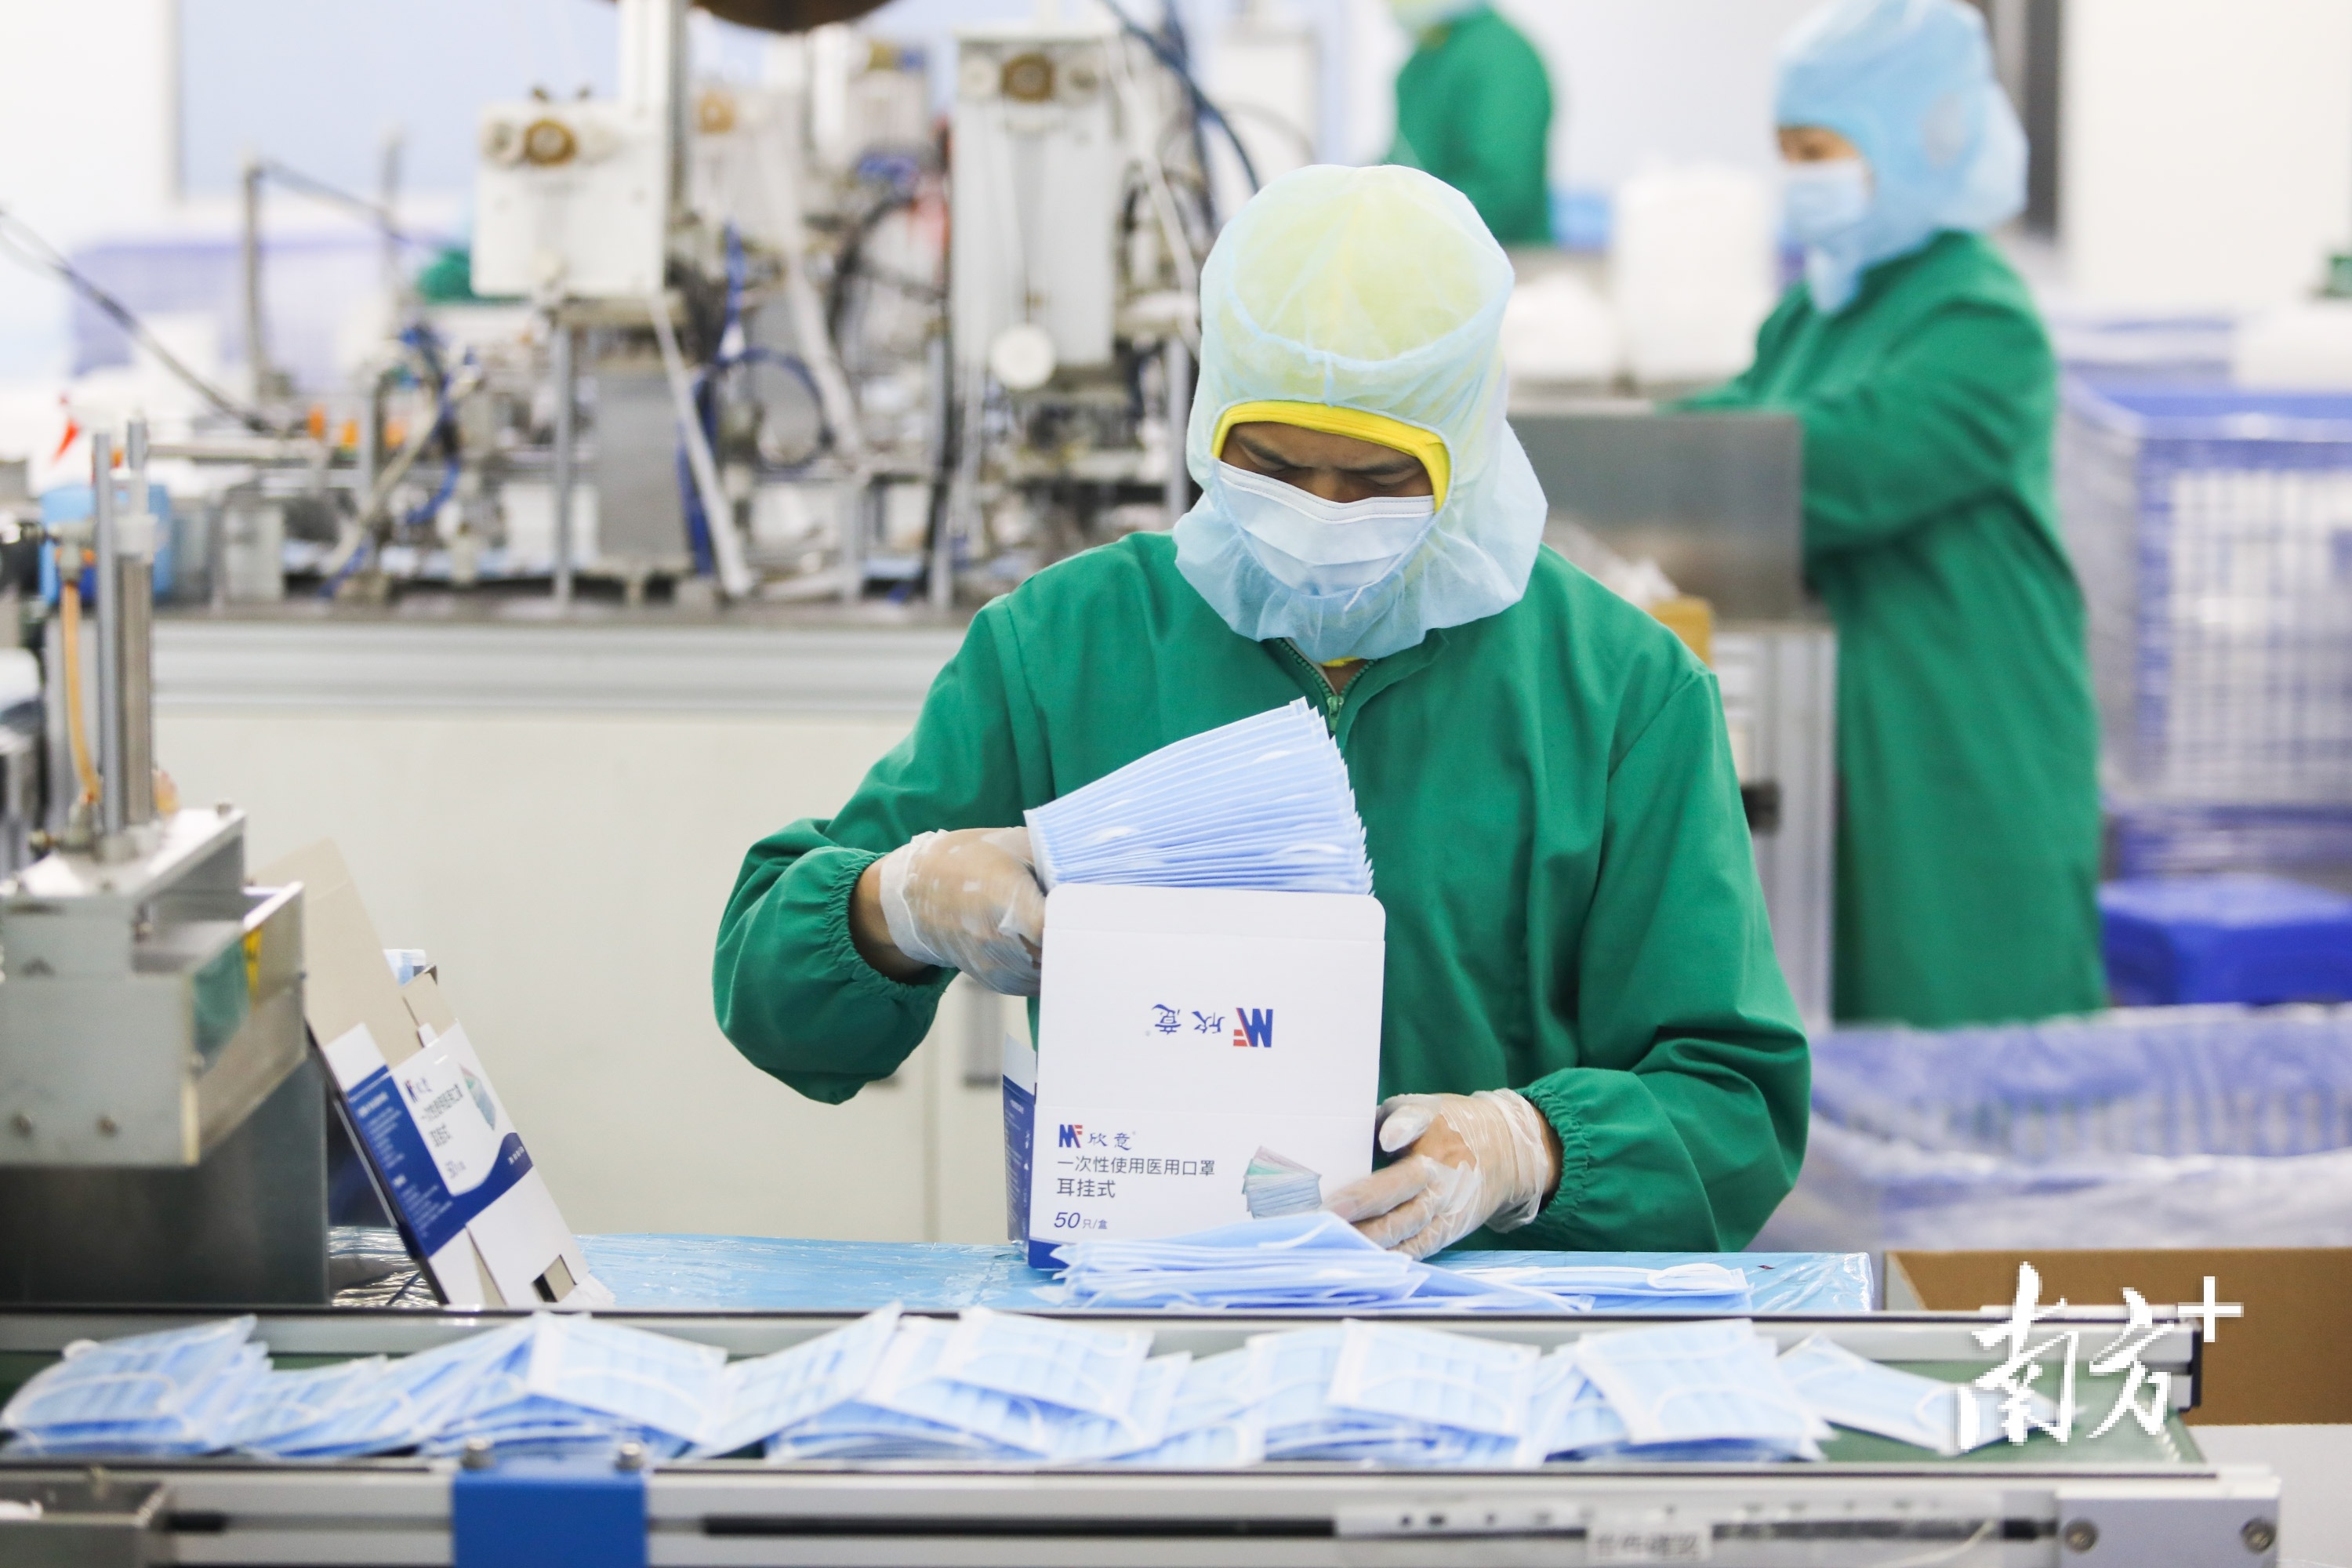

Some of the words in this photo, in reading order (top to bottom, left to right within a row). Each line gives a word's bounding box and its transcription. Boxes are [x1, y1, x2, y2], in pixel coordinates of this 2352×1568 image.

[1152, 1004, 1225, 1036] 欣意
[1087, 1132, 1132, 1151] 欣意
[1057, 1156, 1215, 1176] 一次性使用医用口罩
[1056, 1178, 1116, 1199] 耳挂式
